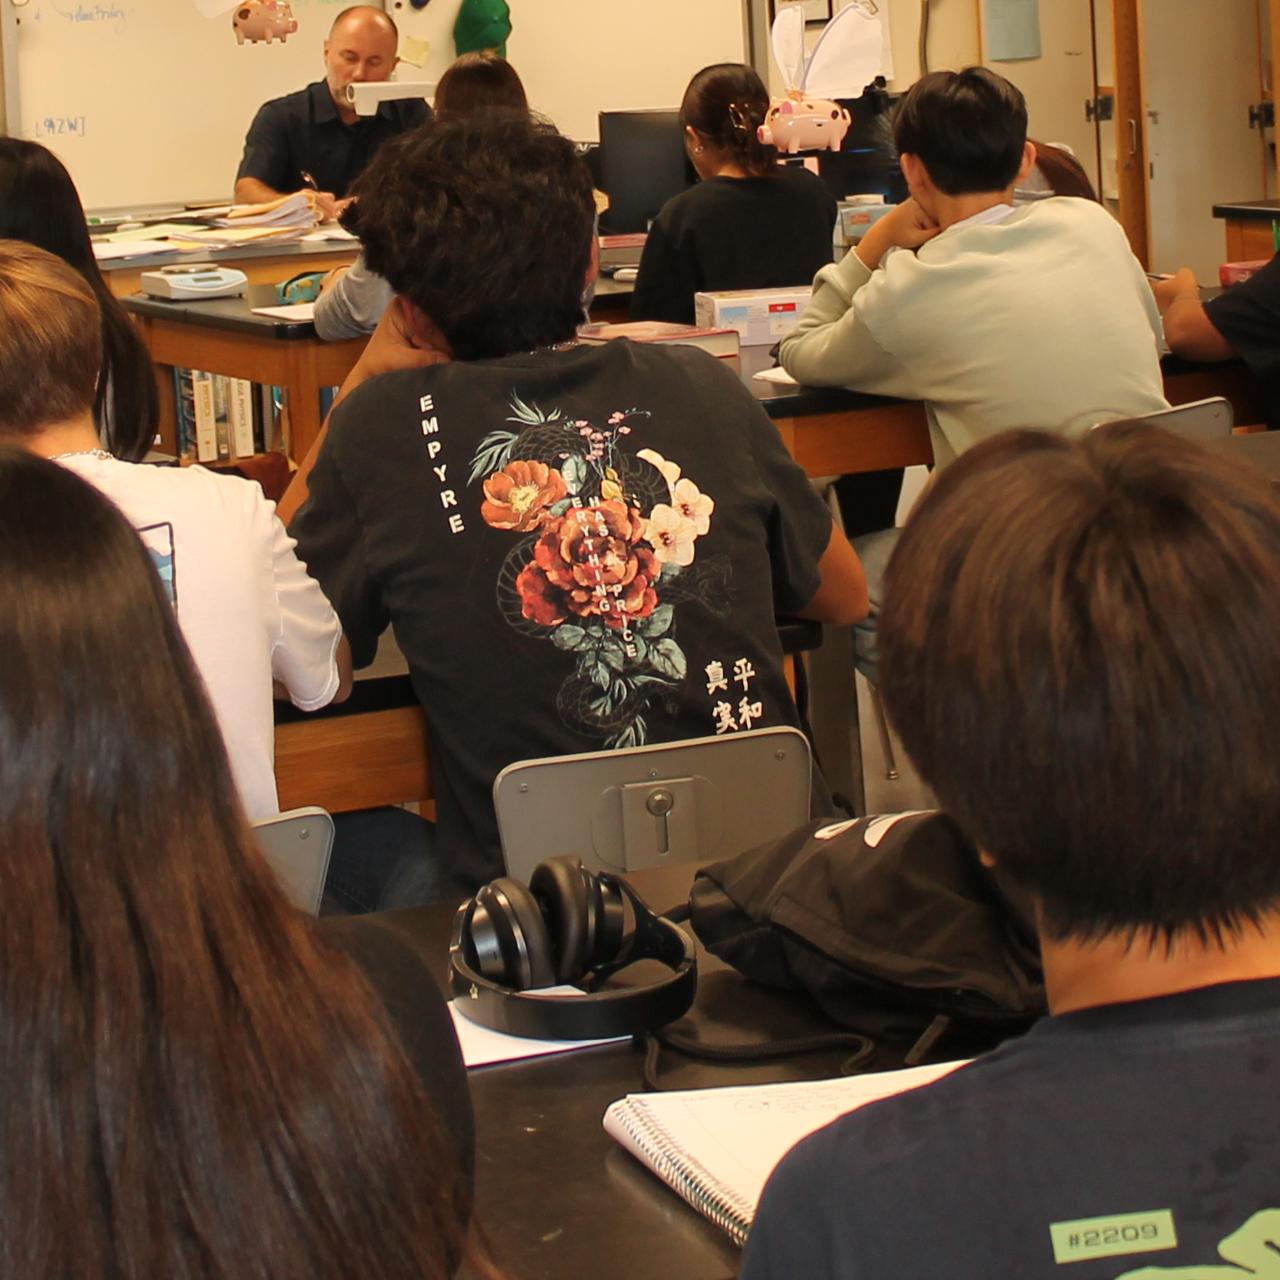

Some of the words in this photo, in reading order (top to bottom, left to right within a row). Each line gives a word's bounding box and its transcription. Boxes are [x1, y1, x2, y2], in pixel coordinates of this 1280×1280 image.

[420, 394, 465, 534] EMPYRE
[564, 469, 611, 612] EVERYTHING
[588, 496, 609, 536] HAS
[612, 584, 638, 658] PRICE
[1068, 1224, 1158, 1249] #2209
